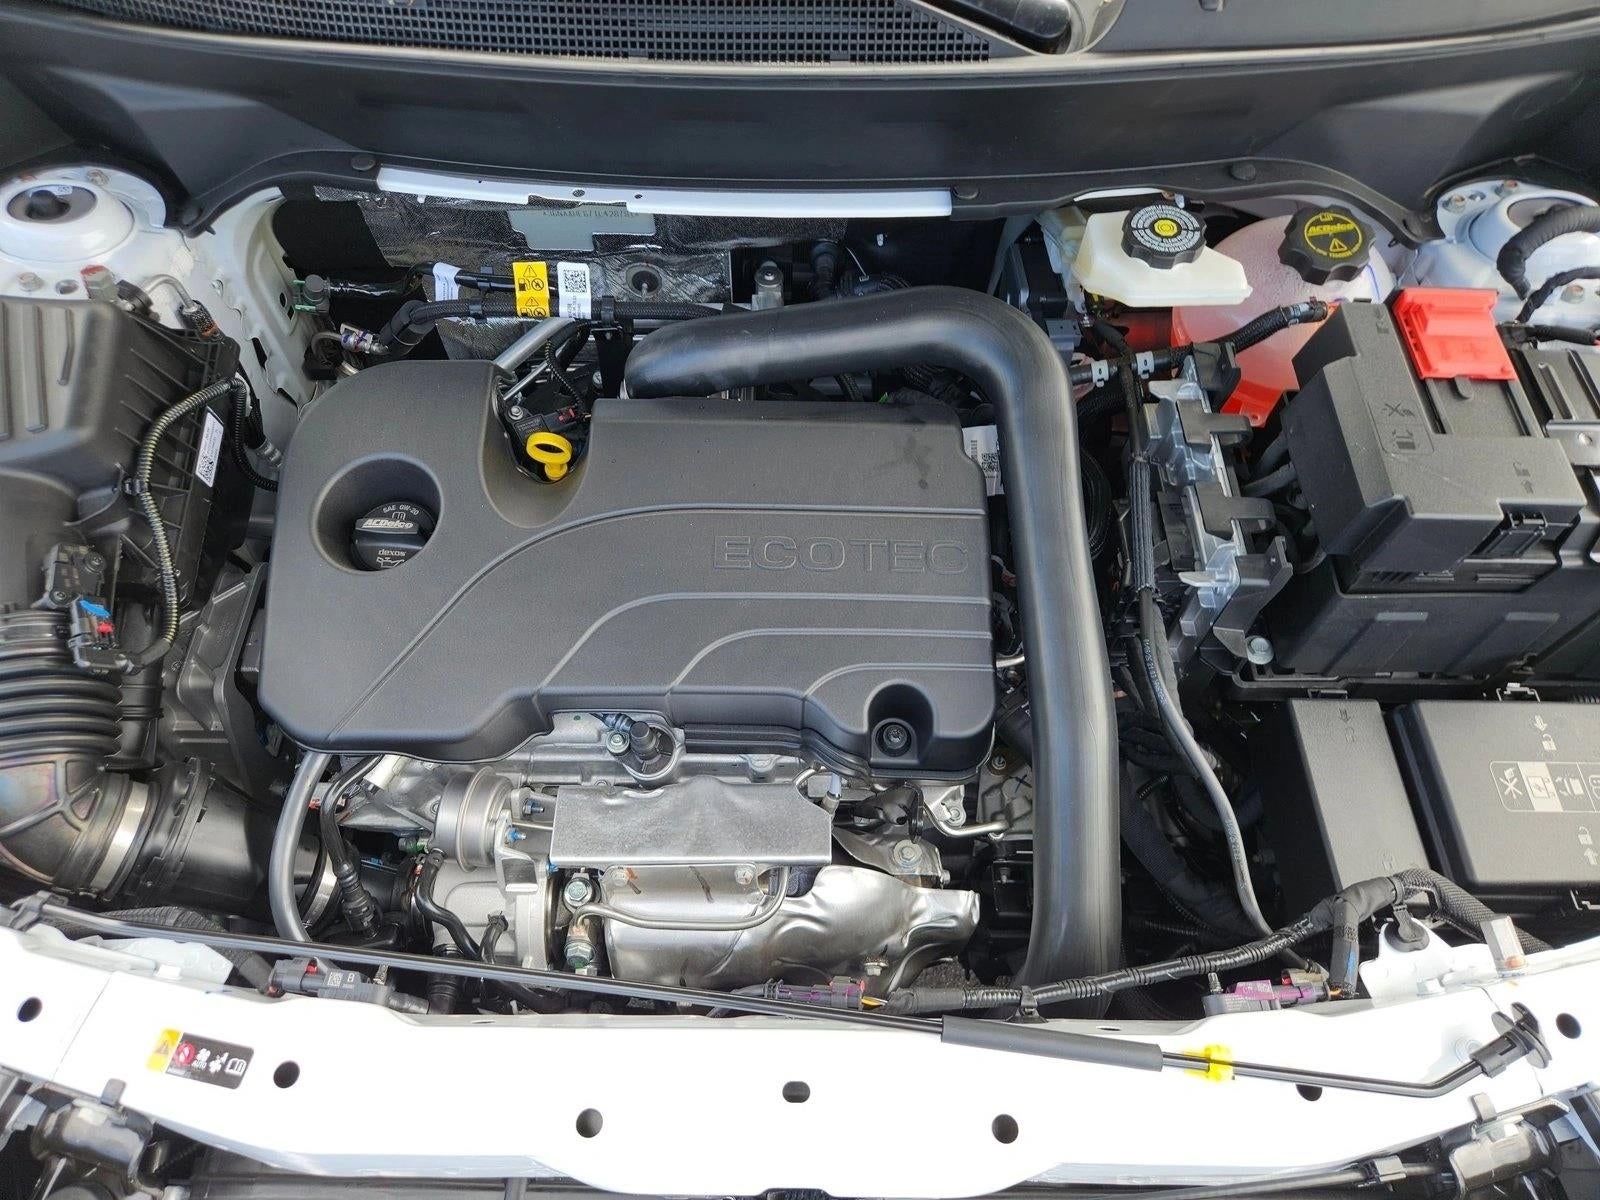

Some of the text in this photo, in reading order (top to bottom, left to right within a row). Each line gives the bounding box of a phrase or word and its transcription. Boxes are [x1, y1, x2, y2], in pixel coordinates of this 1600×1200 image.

[383, 505, 397, 514] SAE
[362, 518, 414, 529] ACDelco
[378, 548, 406, 557] dexos
[713, 535, 969, 575] ECOTEC
